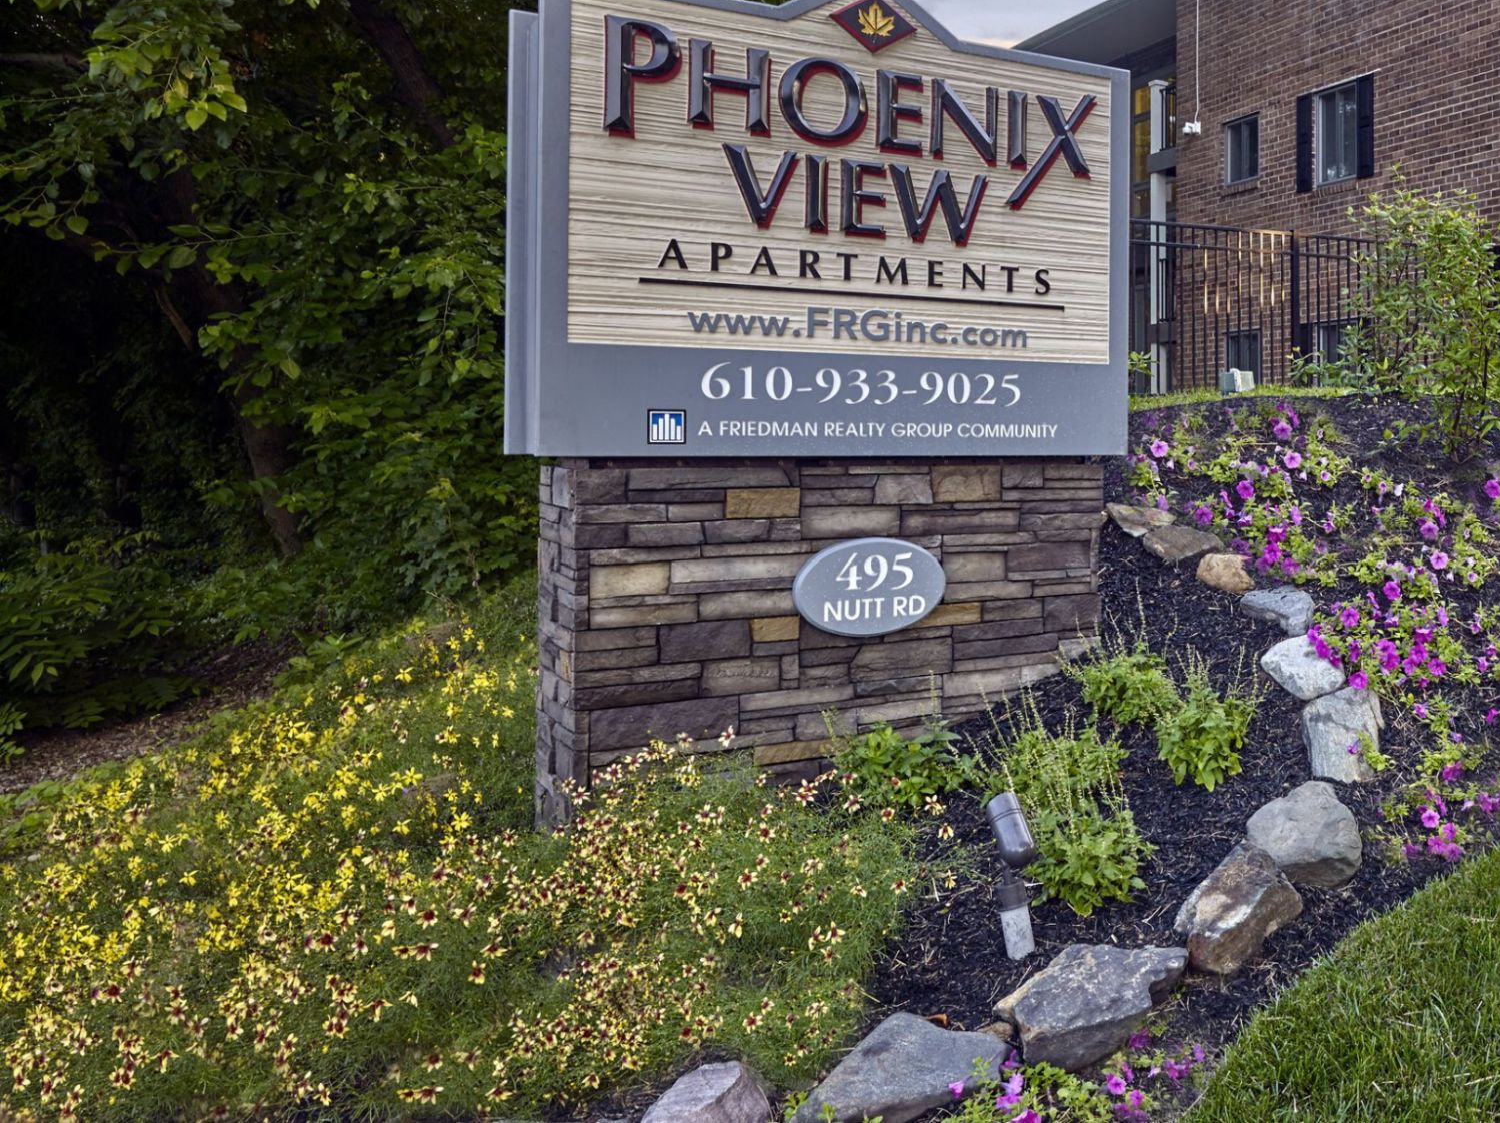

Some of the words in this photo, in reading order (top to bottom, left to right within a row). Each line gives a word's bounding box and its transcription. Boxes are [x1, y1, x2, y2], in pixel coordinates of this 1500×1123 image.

[603, 13, 1097, 210] PHOENIX
[721, 142, 989, 247] VIEW
[657, 237, 1052, 295] APARTMENTS
[687, 306, 1028, 349] www.FRGinc.com
[700, 361, 1022, 407] 610-933-9025
[698, 420, 713, 437] A
[719, 420, 818, 438] FRIEDMAN
[824, 421, 886, 438] REALTY
[891, 422, 954, 439] GROUP
[957, 423, 1058, 439] COMMUNITY
[835, 551, 914, 592] 495
[823, 597, 885, 622] NUTT
[892, 595, 926, 618] RD
